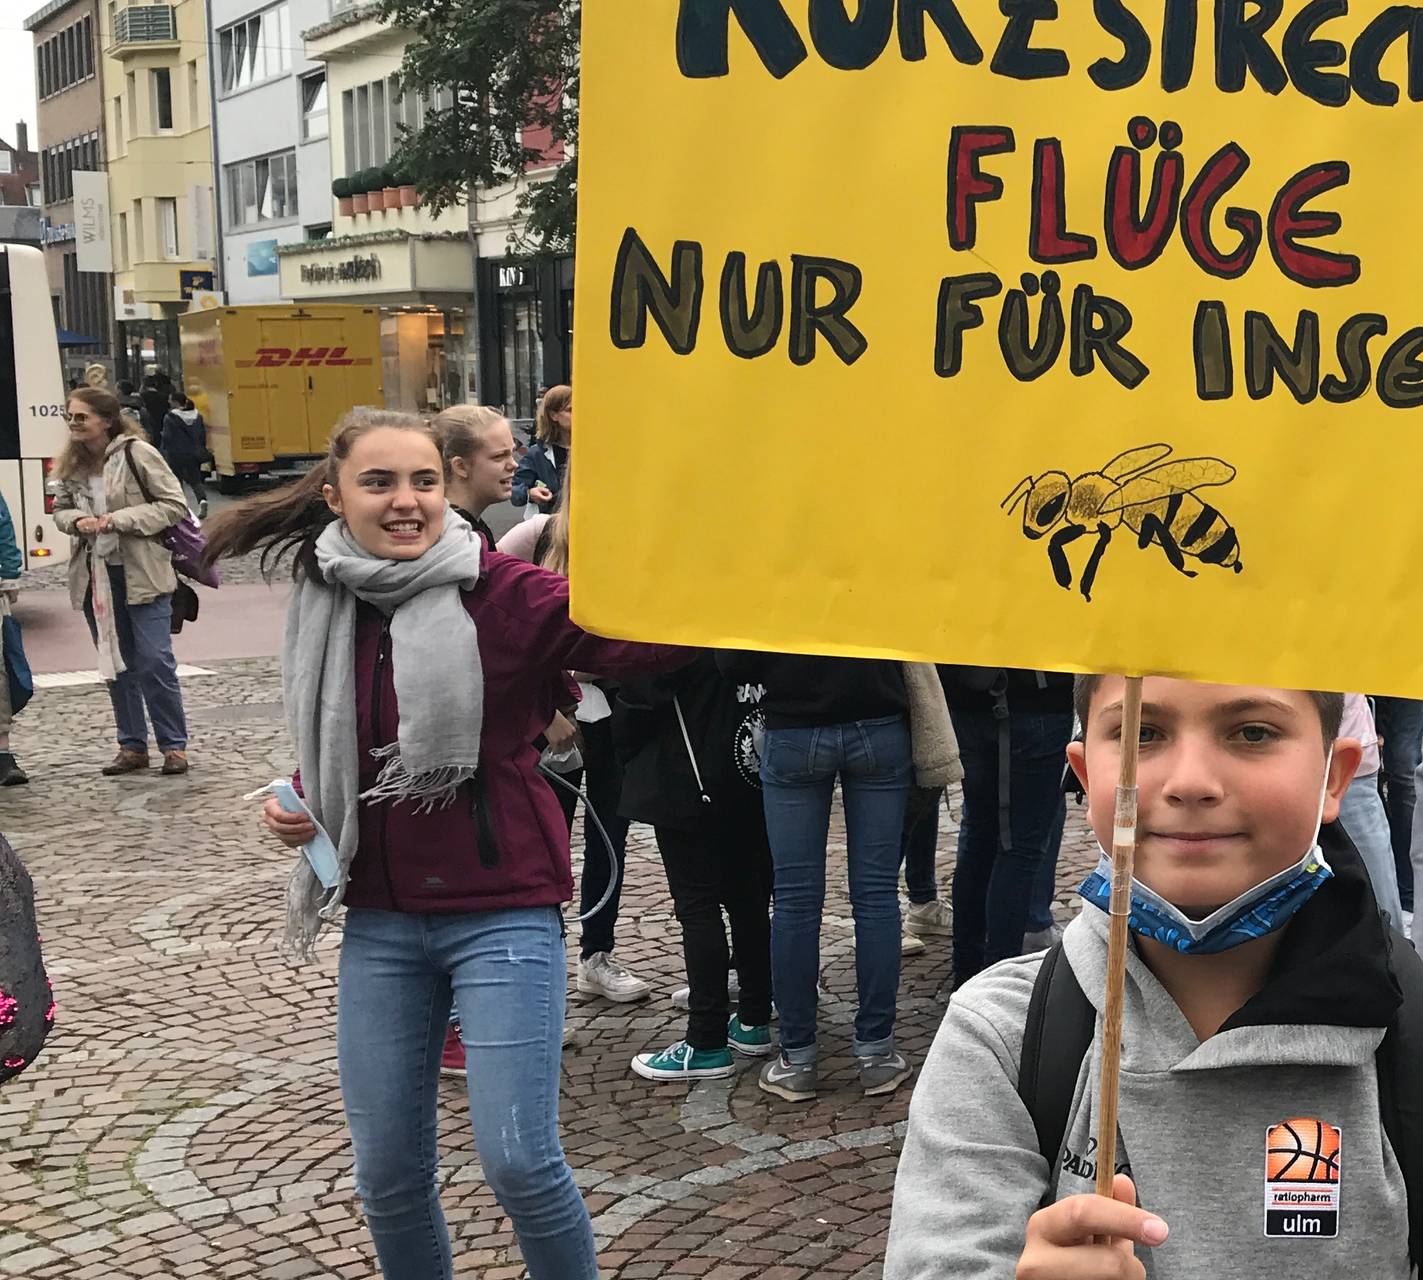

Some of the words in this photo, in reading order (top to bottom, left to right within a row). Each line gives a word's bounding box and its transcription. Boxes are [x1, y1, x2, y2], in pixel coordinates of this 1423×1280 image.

[946, 116, 1361, 288] FLÜGE
[81, 198, 96, 244] WILMS
[610, 227, 868, 366] NUR
[934, 270, 1150, 390] FÜR
[255, 347, 353, 367] DHL
[1274, 1192, 1331, 1204] ratiopharm
[1283, 1214, 1321, 1233] ulm
